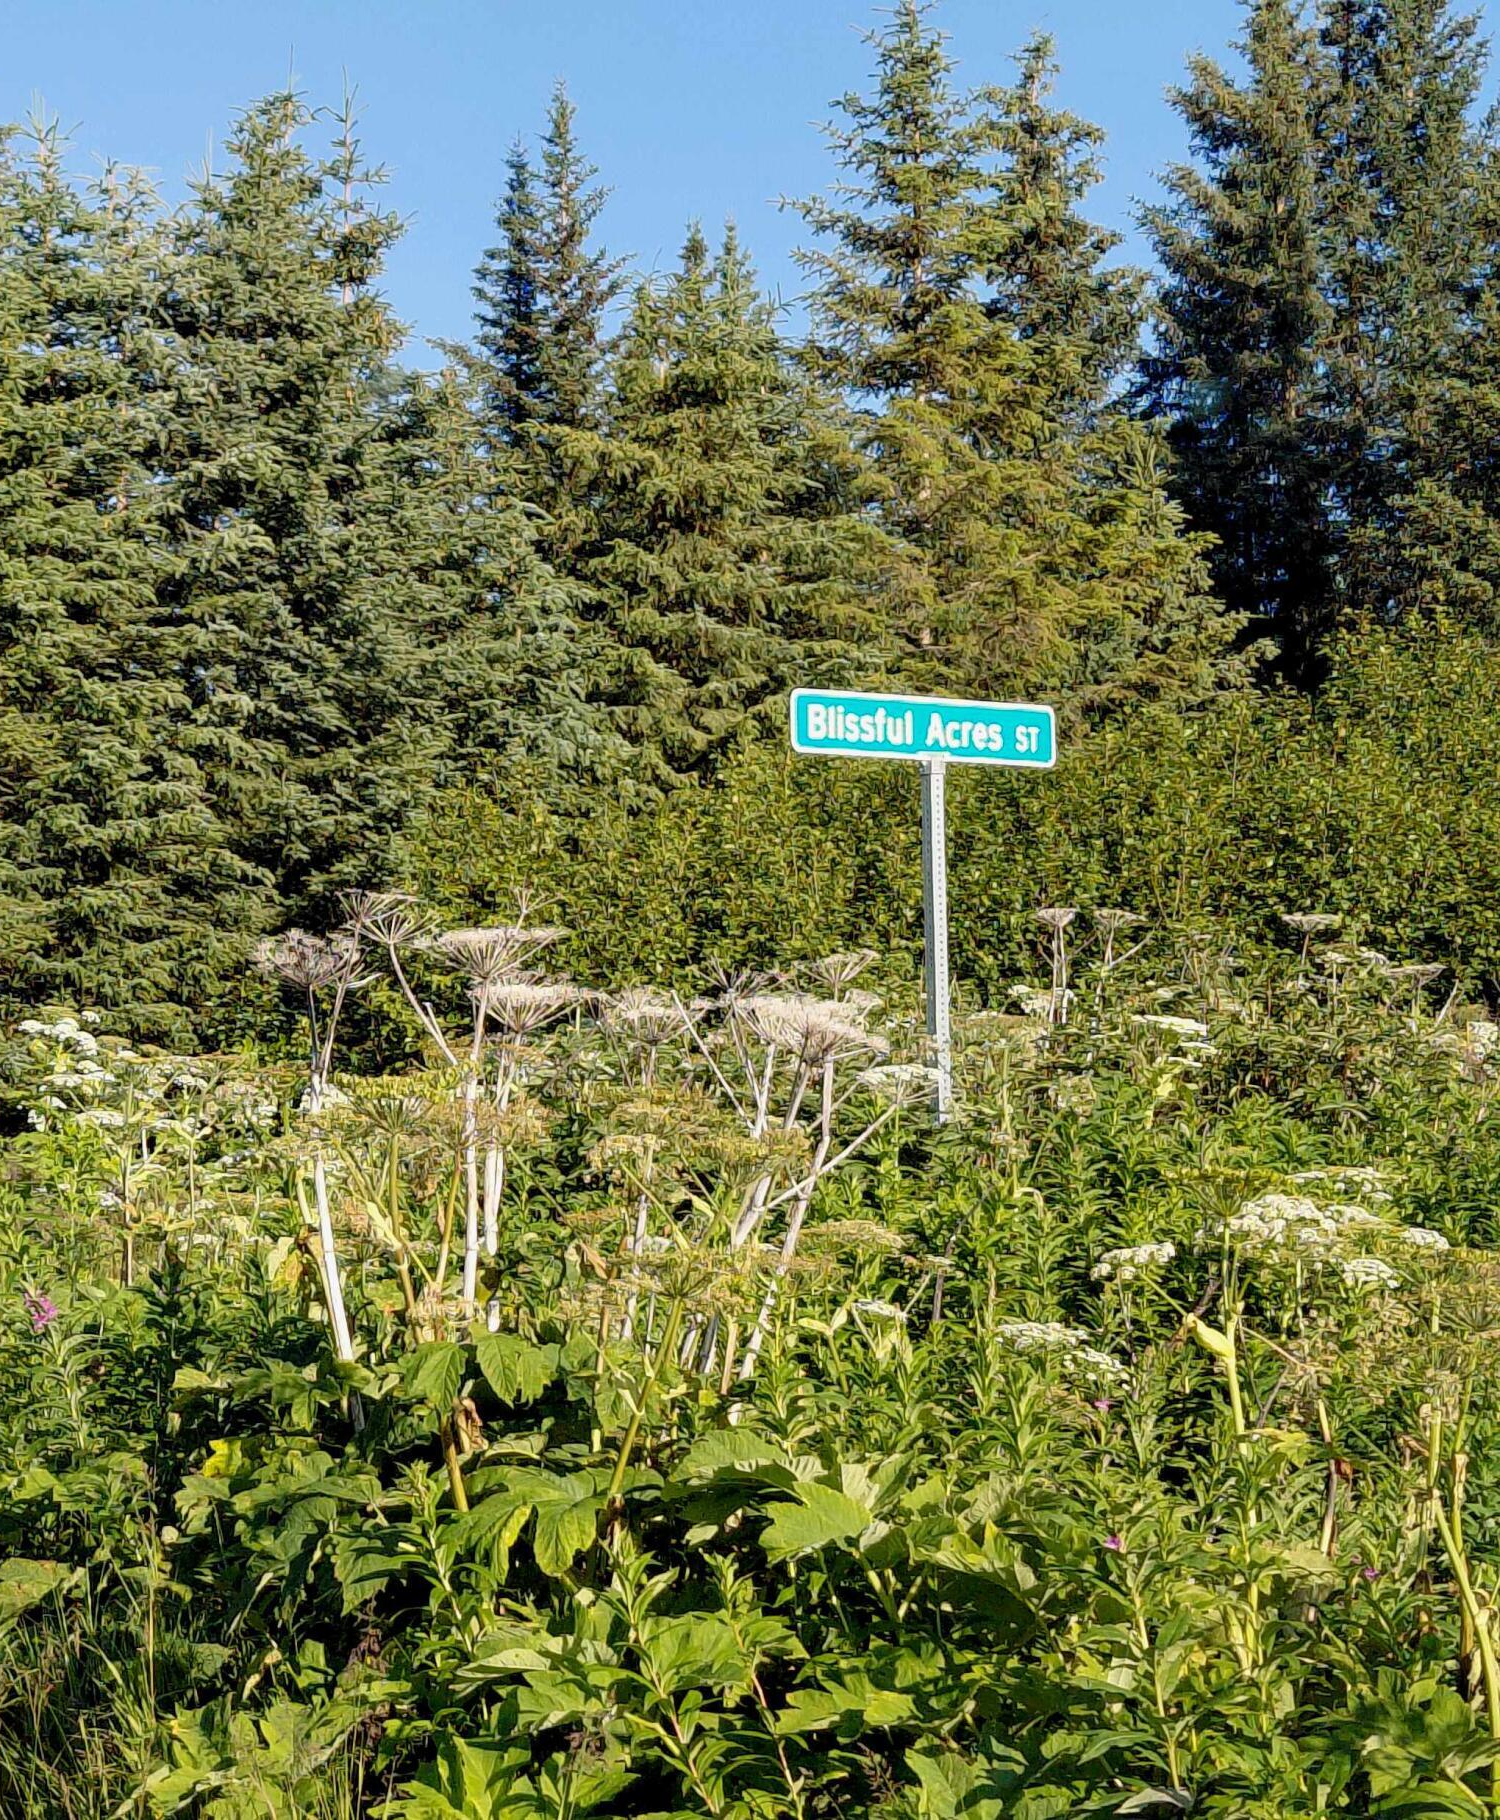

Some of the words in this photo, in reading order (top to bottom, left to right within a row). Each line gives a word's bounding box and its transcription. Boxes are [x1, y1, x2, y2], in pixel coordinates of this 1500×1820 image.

[807, 703, 913, 745] Blissful
[925, 712, 1003, 751] Acres
[1015, 725, 1040, 753] ST
